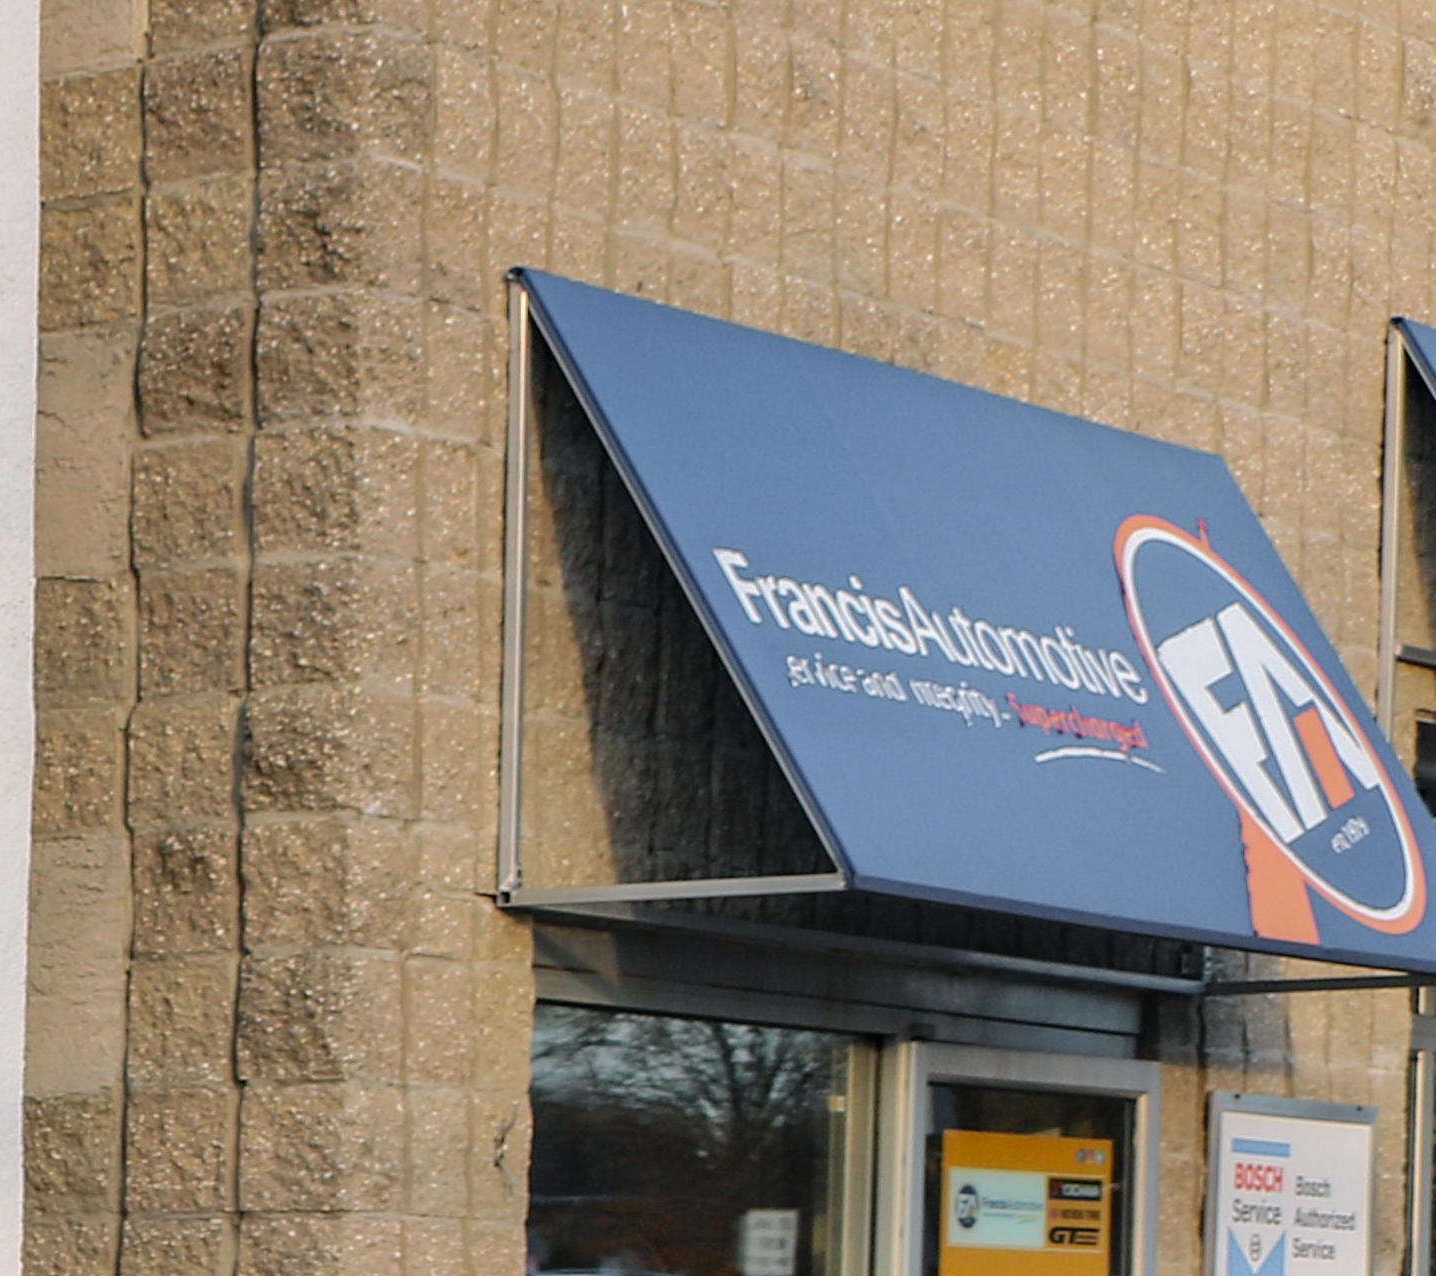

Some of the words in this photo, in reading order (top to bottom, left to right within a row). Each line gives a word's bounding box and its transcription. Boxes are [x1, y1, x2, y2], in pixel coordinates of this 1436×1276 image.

[1235, 1162, 1284, 1192] BOSCH
[1232, 1198, 1281, 1225] Service
[1293, 1236, 1335, 1260] Service
